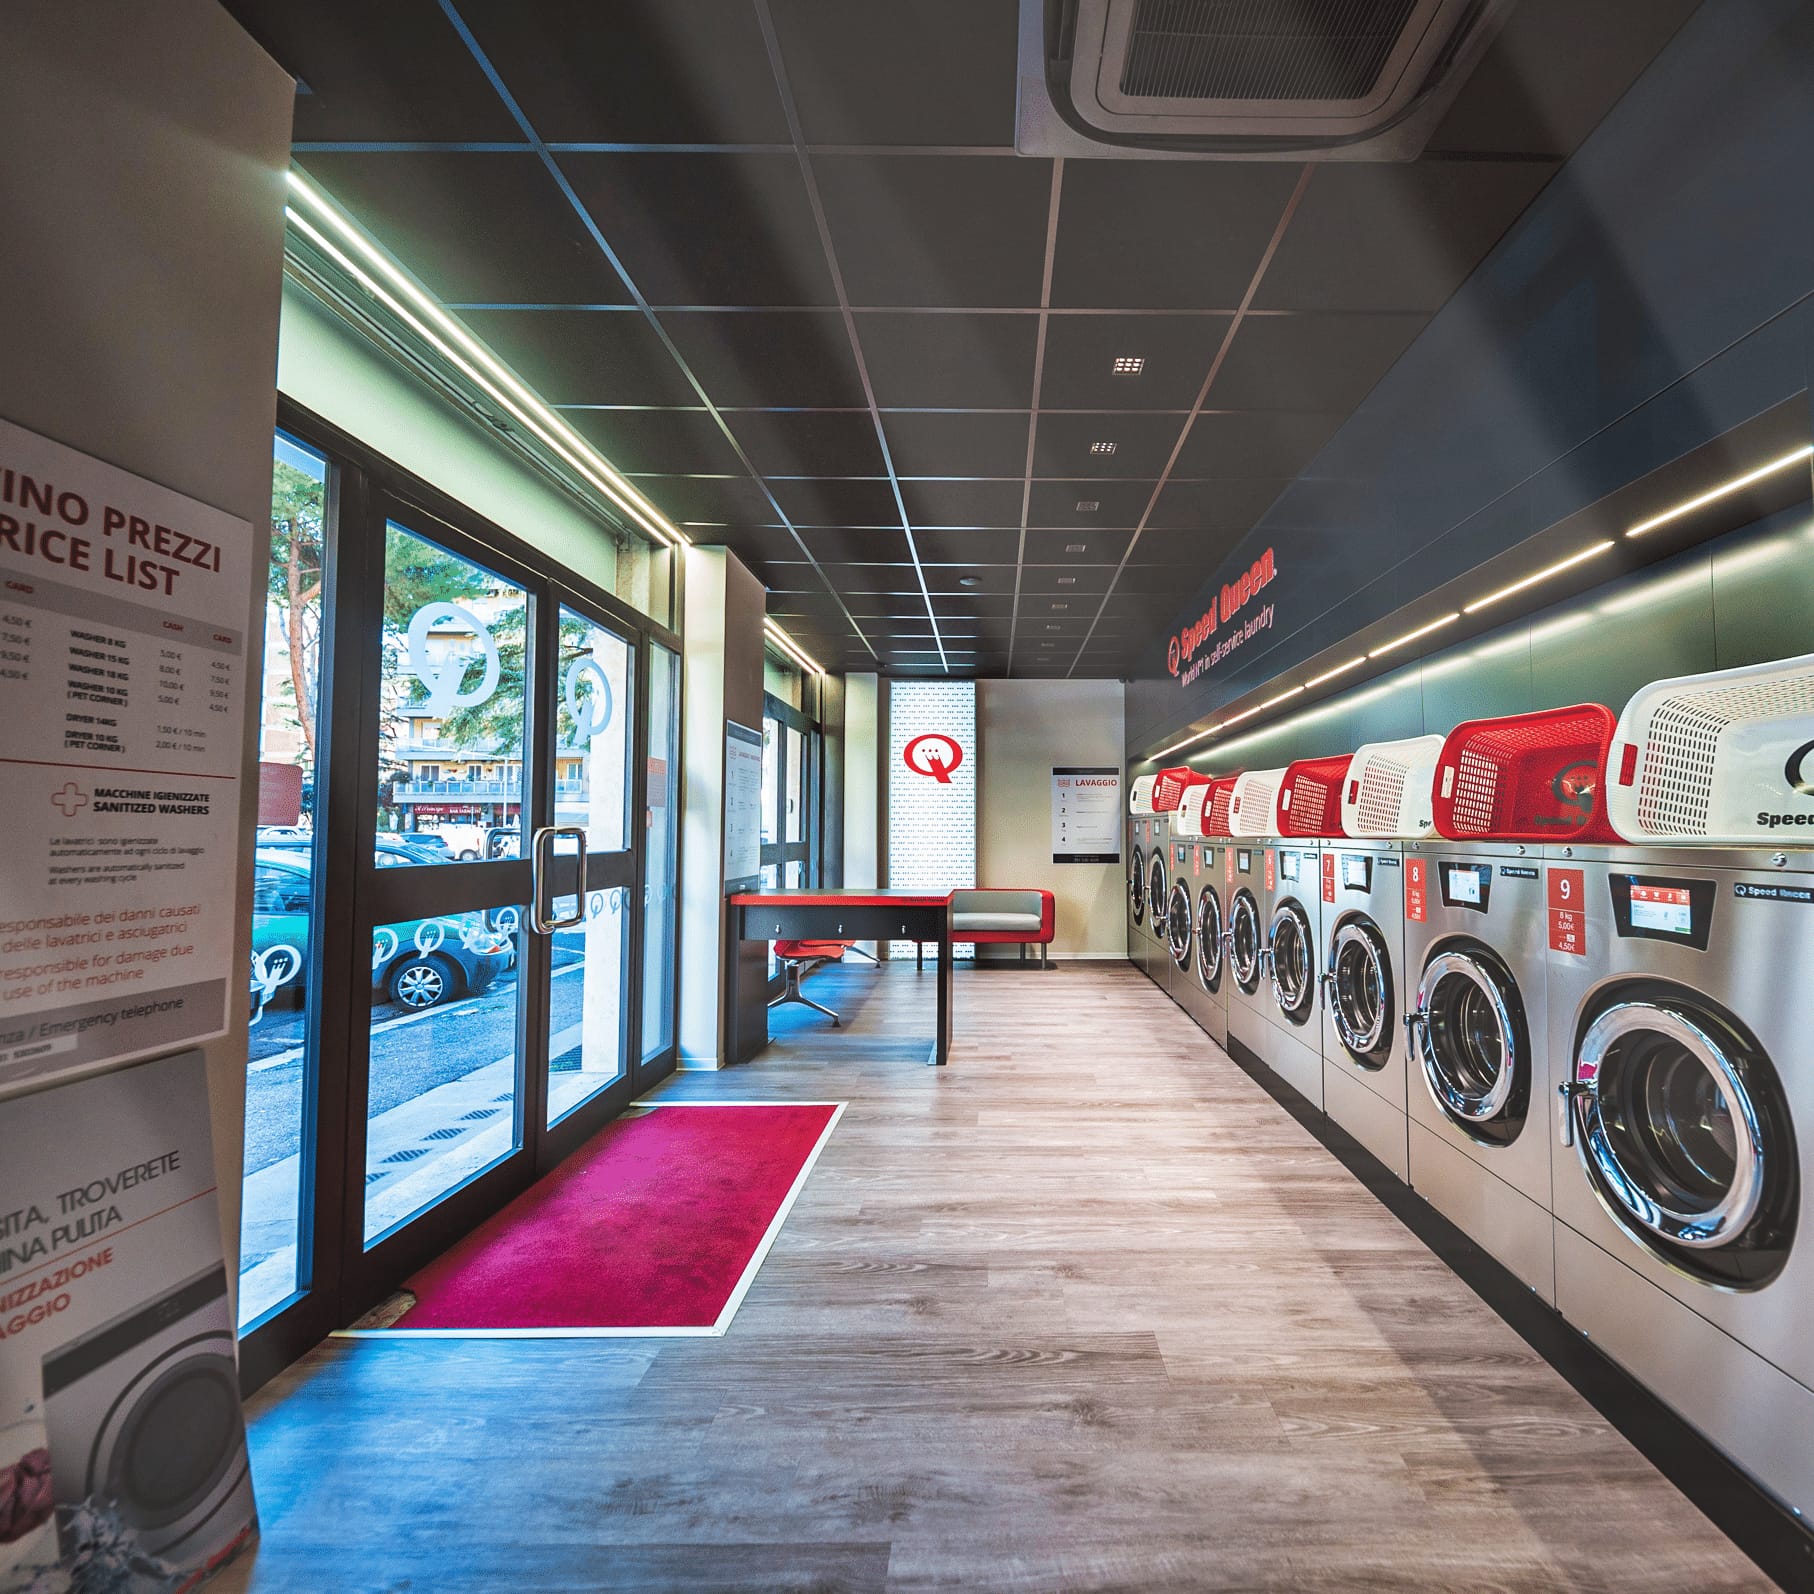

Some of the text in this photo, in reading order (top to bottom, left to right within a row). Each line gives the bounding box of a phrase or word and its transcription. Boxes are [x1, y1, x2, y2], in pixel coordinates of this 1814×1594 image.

[0, 467, 221, 573] INO PREZZI
[0, 513, 181, 596] RICE LIST
[1181, 596, 1217, 662] Speed
[1210, 629, 1244, 666] self-service
[1244, 603, 1275, 641] laundry
[70, 630, 106, 644] WASHER
[114, 640, 127, 648] KG
[69, 646, 105, 660] WASHER
[118, 657, 129, 665] KG
[68, 663, 105, 677] WASHER
[117, 672, 129, 681] KG
[67, 680, 104, 693] WASHER
[116, 688, 128, 697] KG
[72, 691, 88, 700] PET
[89, 693, 123, 705] CORNER
[66, 713, 94, 724] DRYER
[65, 730, 93, 741] DRYER
[1075, 779, 1118, 787] LAVAGGIO
[94, 788, 209, 802] MACCHINE IGIENIZZATE
[93, 801, 209, 815] SANITIZED WASHERS
[1413, 867, 1419, 882] 8
[1560, 879, 1571, 900] 9
[1748, 886, 1777, 896] Speed
[94, 909, 115, 924] dei
[119, 907, 156, 923] danni
[159, 903, 201, 917] causati
[1565, 912, 1573, 921] kg
[4, 921, 188, 954] delle lavatrici e asciugatrici
[92, 953, 112, 968] for
[116, 947, 167, 965] damage
[170, 943, 194, 957] due
[3, 968, 144, 1000] use of the machine
[39, 1009, 119, 1038] Emergency
[121, 998, 184, 1020] telephone
[0, 1150, 181, 1241] ITA, TROVERETE
[0, 1205, 123, 1274] INA PULITA
